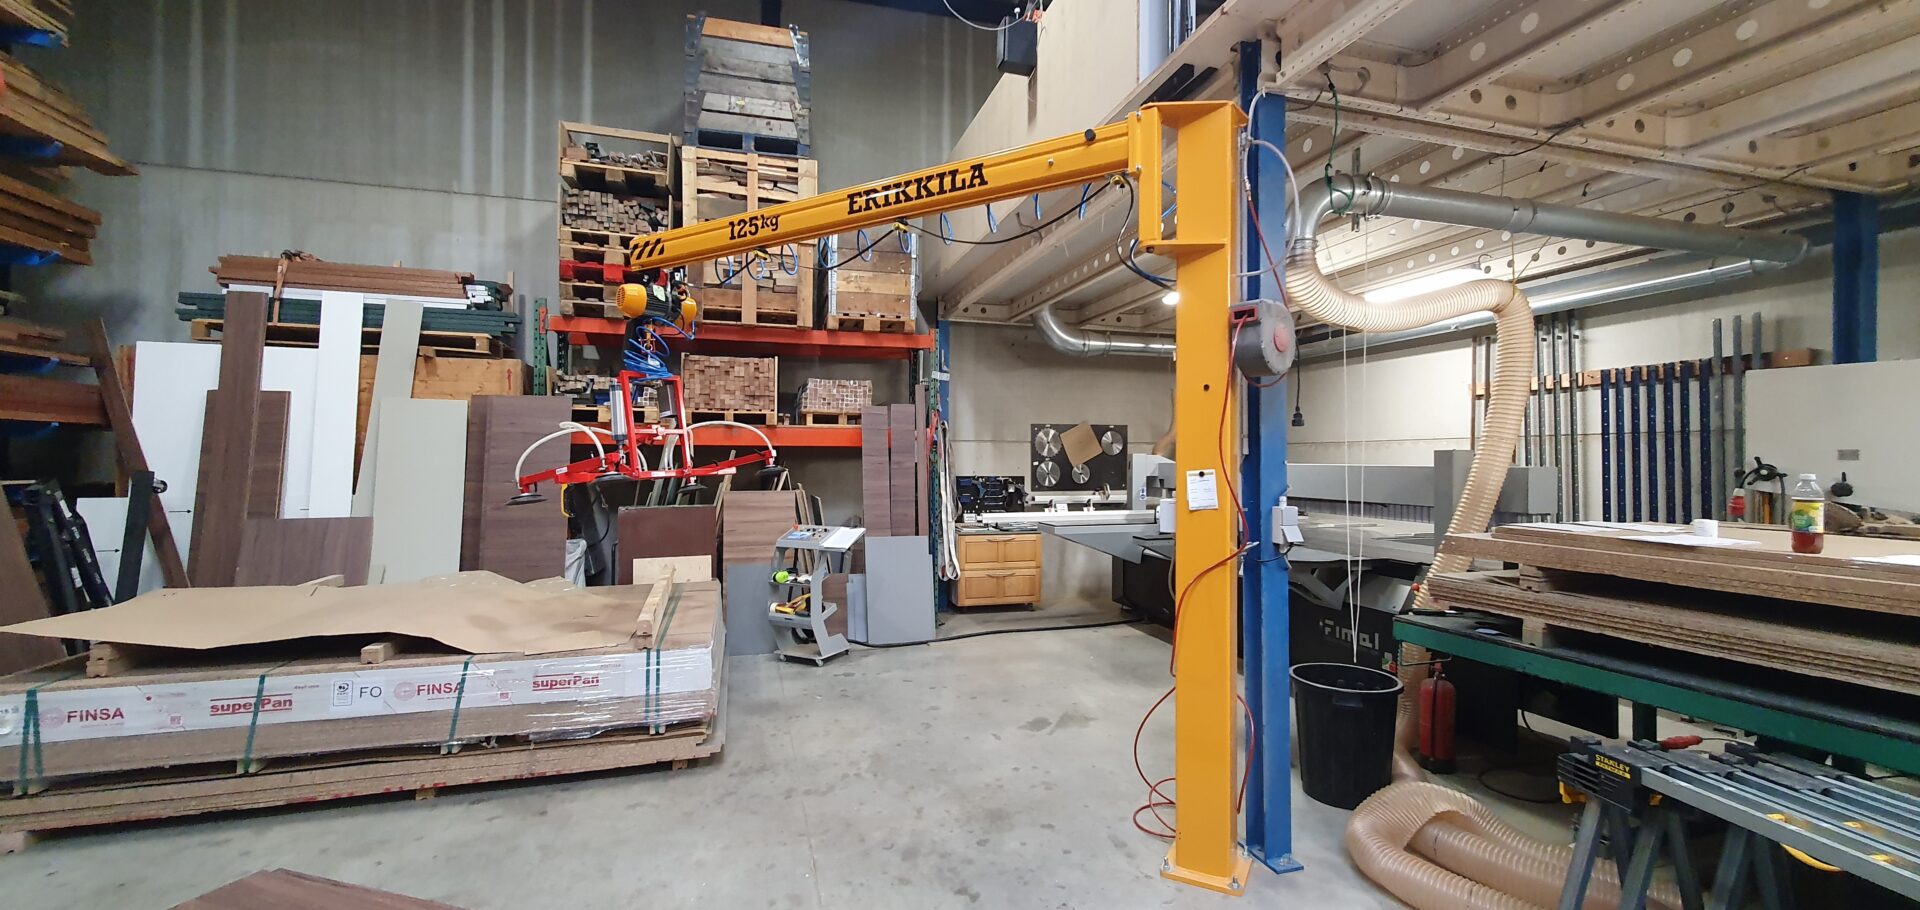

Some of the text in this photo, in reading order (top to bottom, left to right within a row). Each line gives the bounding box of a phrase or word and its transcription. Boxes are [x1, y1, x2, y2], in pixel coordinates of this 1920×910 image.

[847, 163, 988, 215] ERIKKILA
[532, 675, 600, 689] superPan
[359, 686, 382, 699] FO
[210, 697, 293, 714] supePan
[66, 708, 125, 723] FINSA
[1595, 754, 1630, 772] STANLEY
